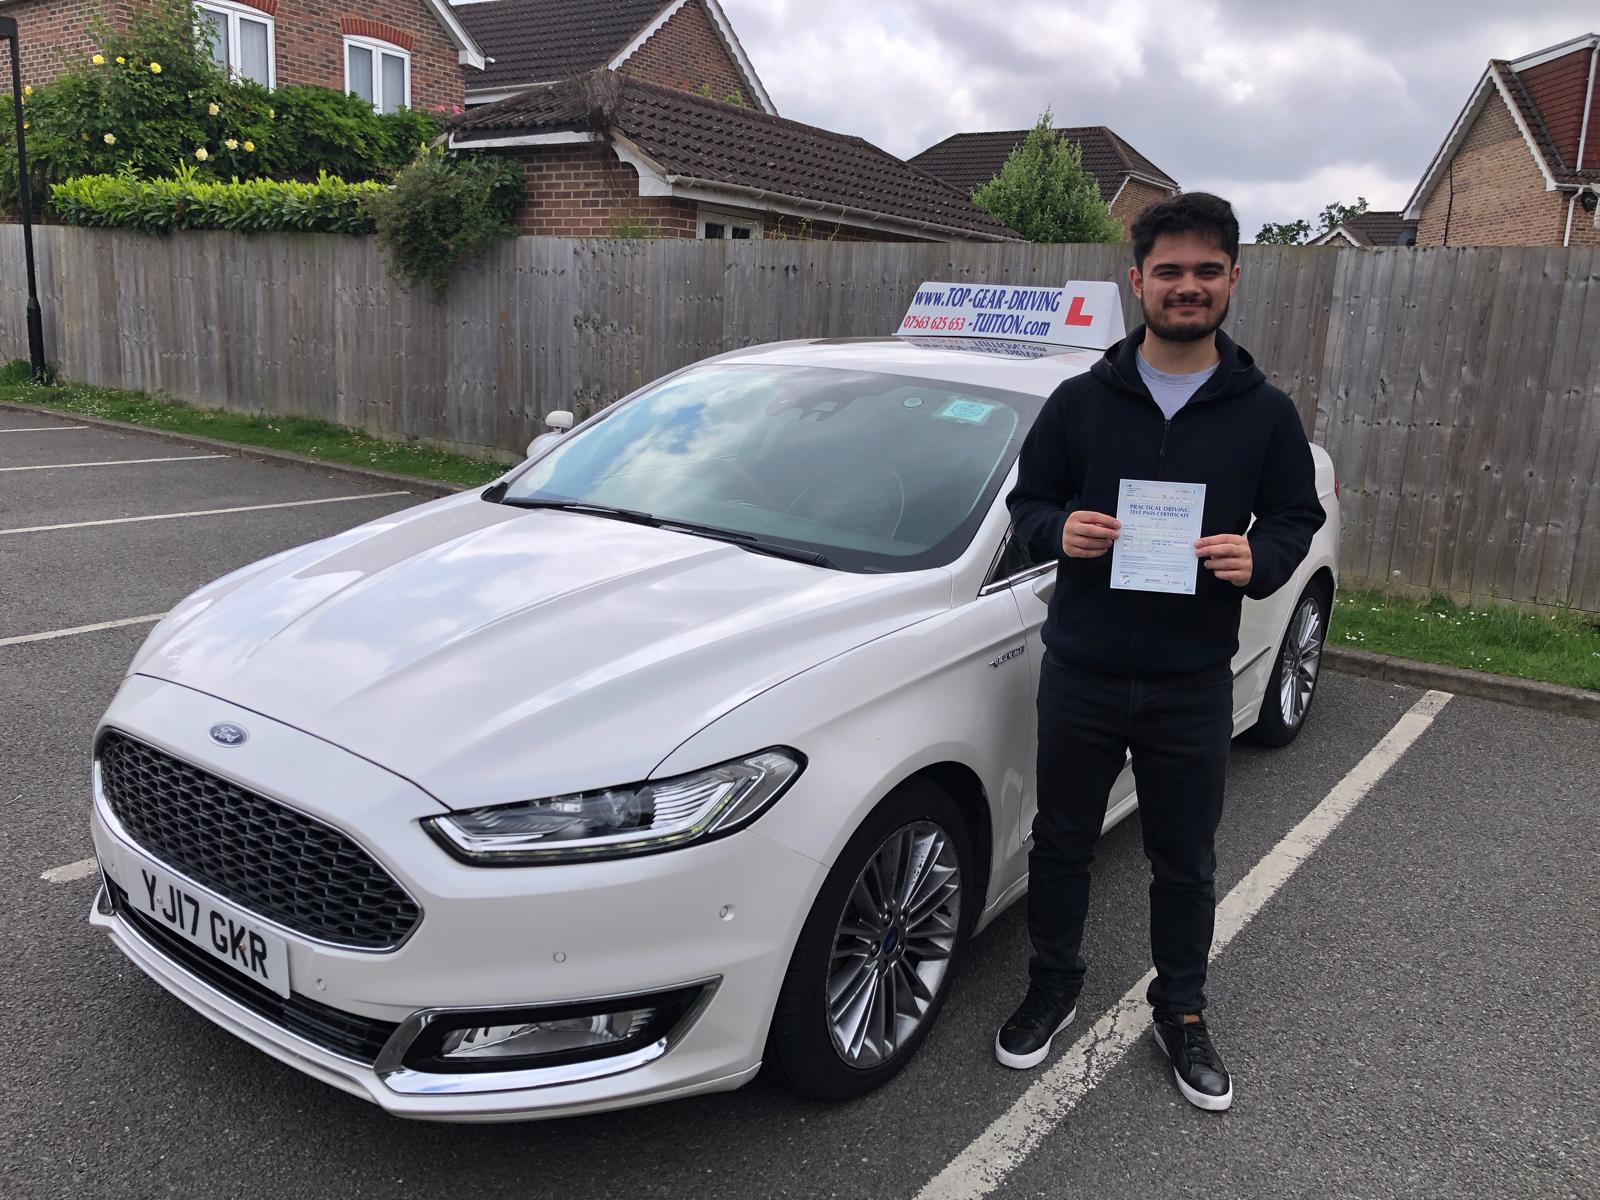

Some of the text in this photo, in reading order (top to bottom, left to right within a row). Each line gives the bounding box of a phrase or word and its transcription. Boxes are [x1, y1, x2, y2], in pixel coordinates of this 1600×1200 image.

[914, 287, 1062, 313] www.TOP-GEAR-DRIVING
[1064, 296, 1094, 327] L
[903, 314, 966, 331] 07563 625 653
[1129, 504, 1190, 513] PRACTICAL DRIVING
[1156, 511, 1190, 519] CERTIFICATE
[213, 726, 241, 743] Ford
[141, 868, 269, 980] YJ17 GKR
